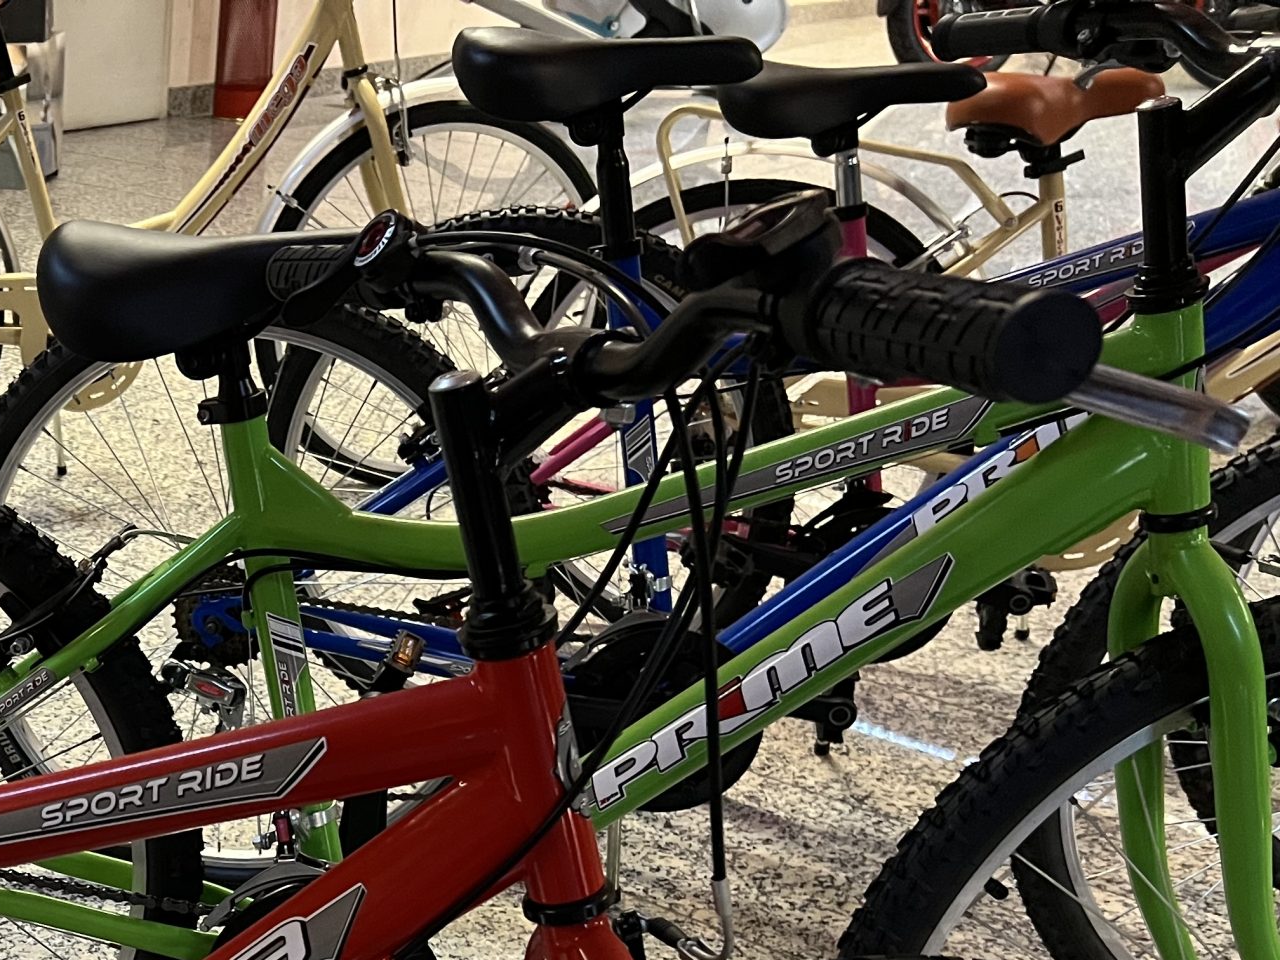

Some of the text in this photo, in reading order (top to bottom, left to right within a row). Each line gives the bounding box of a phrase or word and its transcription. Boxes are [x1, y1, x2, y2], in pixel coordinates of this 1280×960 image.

[1028, 252, 1105, 288] SPORT
[775, 407, 950, 484] SPORT RIDE
[40, 753, 265, 829] SPORT RIDE
